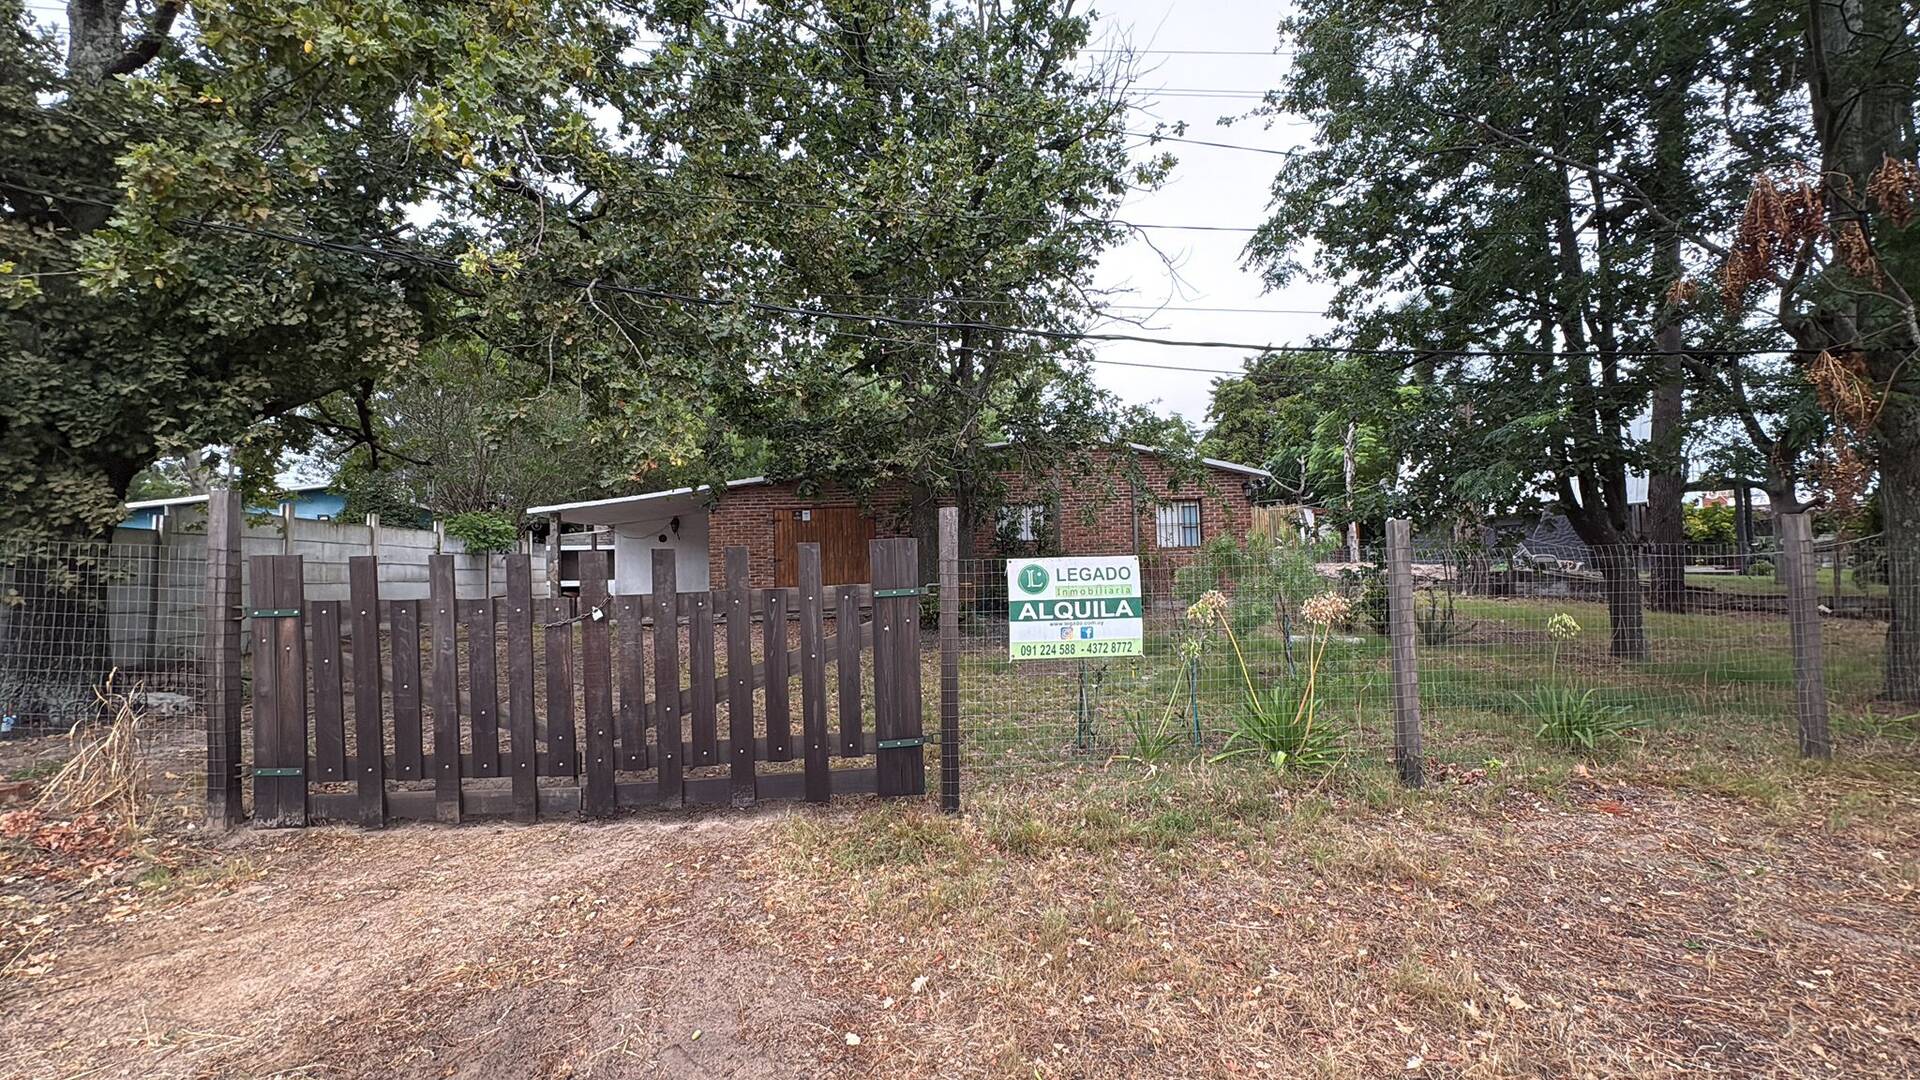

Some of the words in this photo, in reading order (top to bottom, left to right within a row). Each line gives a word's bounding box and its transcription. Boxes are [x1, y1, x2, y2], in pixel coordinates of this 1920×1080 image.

[1056, 566, 1131, 582] LEGADO
[1057, 586, 1132, 596] Inmobiliaria
[1018, 600, 1134, 620] ALQUILA
[1020, 644, 1037, 656] 091
[1040, 644, 1056, 656] 224
[1059, 643, 1076, 655] 588
[1086, 642, 1109, 654] 4372
[1111, 641, 1133, 653] 8772
